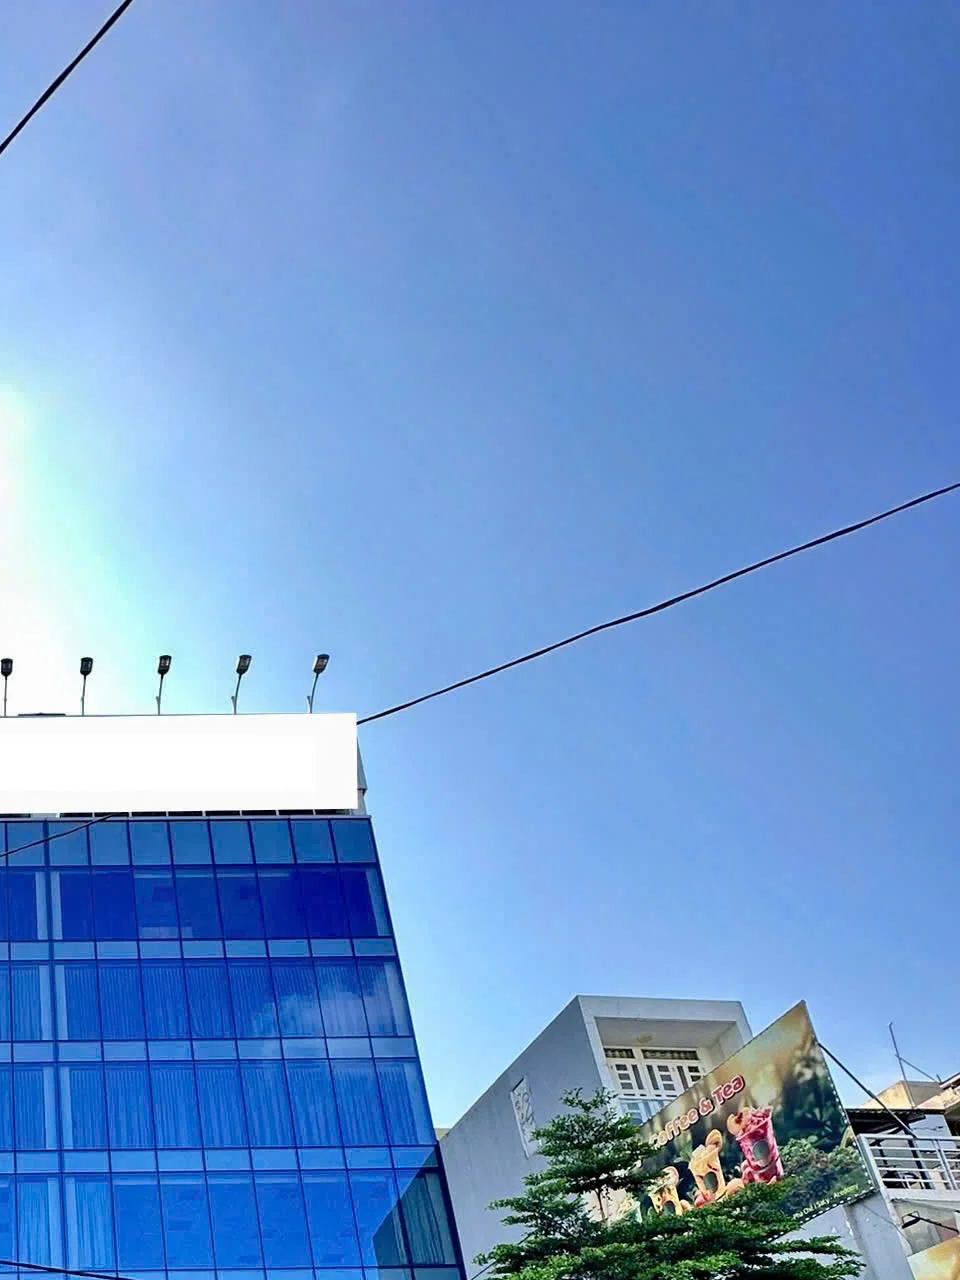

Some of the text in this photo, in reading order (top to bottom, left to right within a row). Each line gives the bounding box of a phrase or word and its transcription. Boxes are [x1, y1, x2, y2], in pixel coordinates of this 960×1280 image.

[649, 1075, 745, 1150] Coffee & Tea
